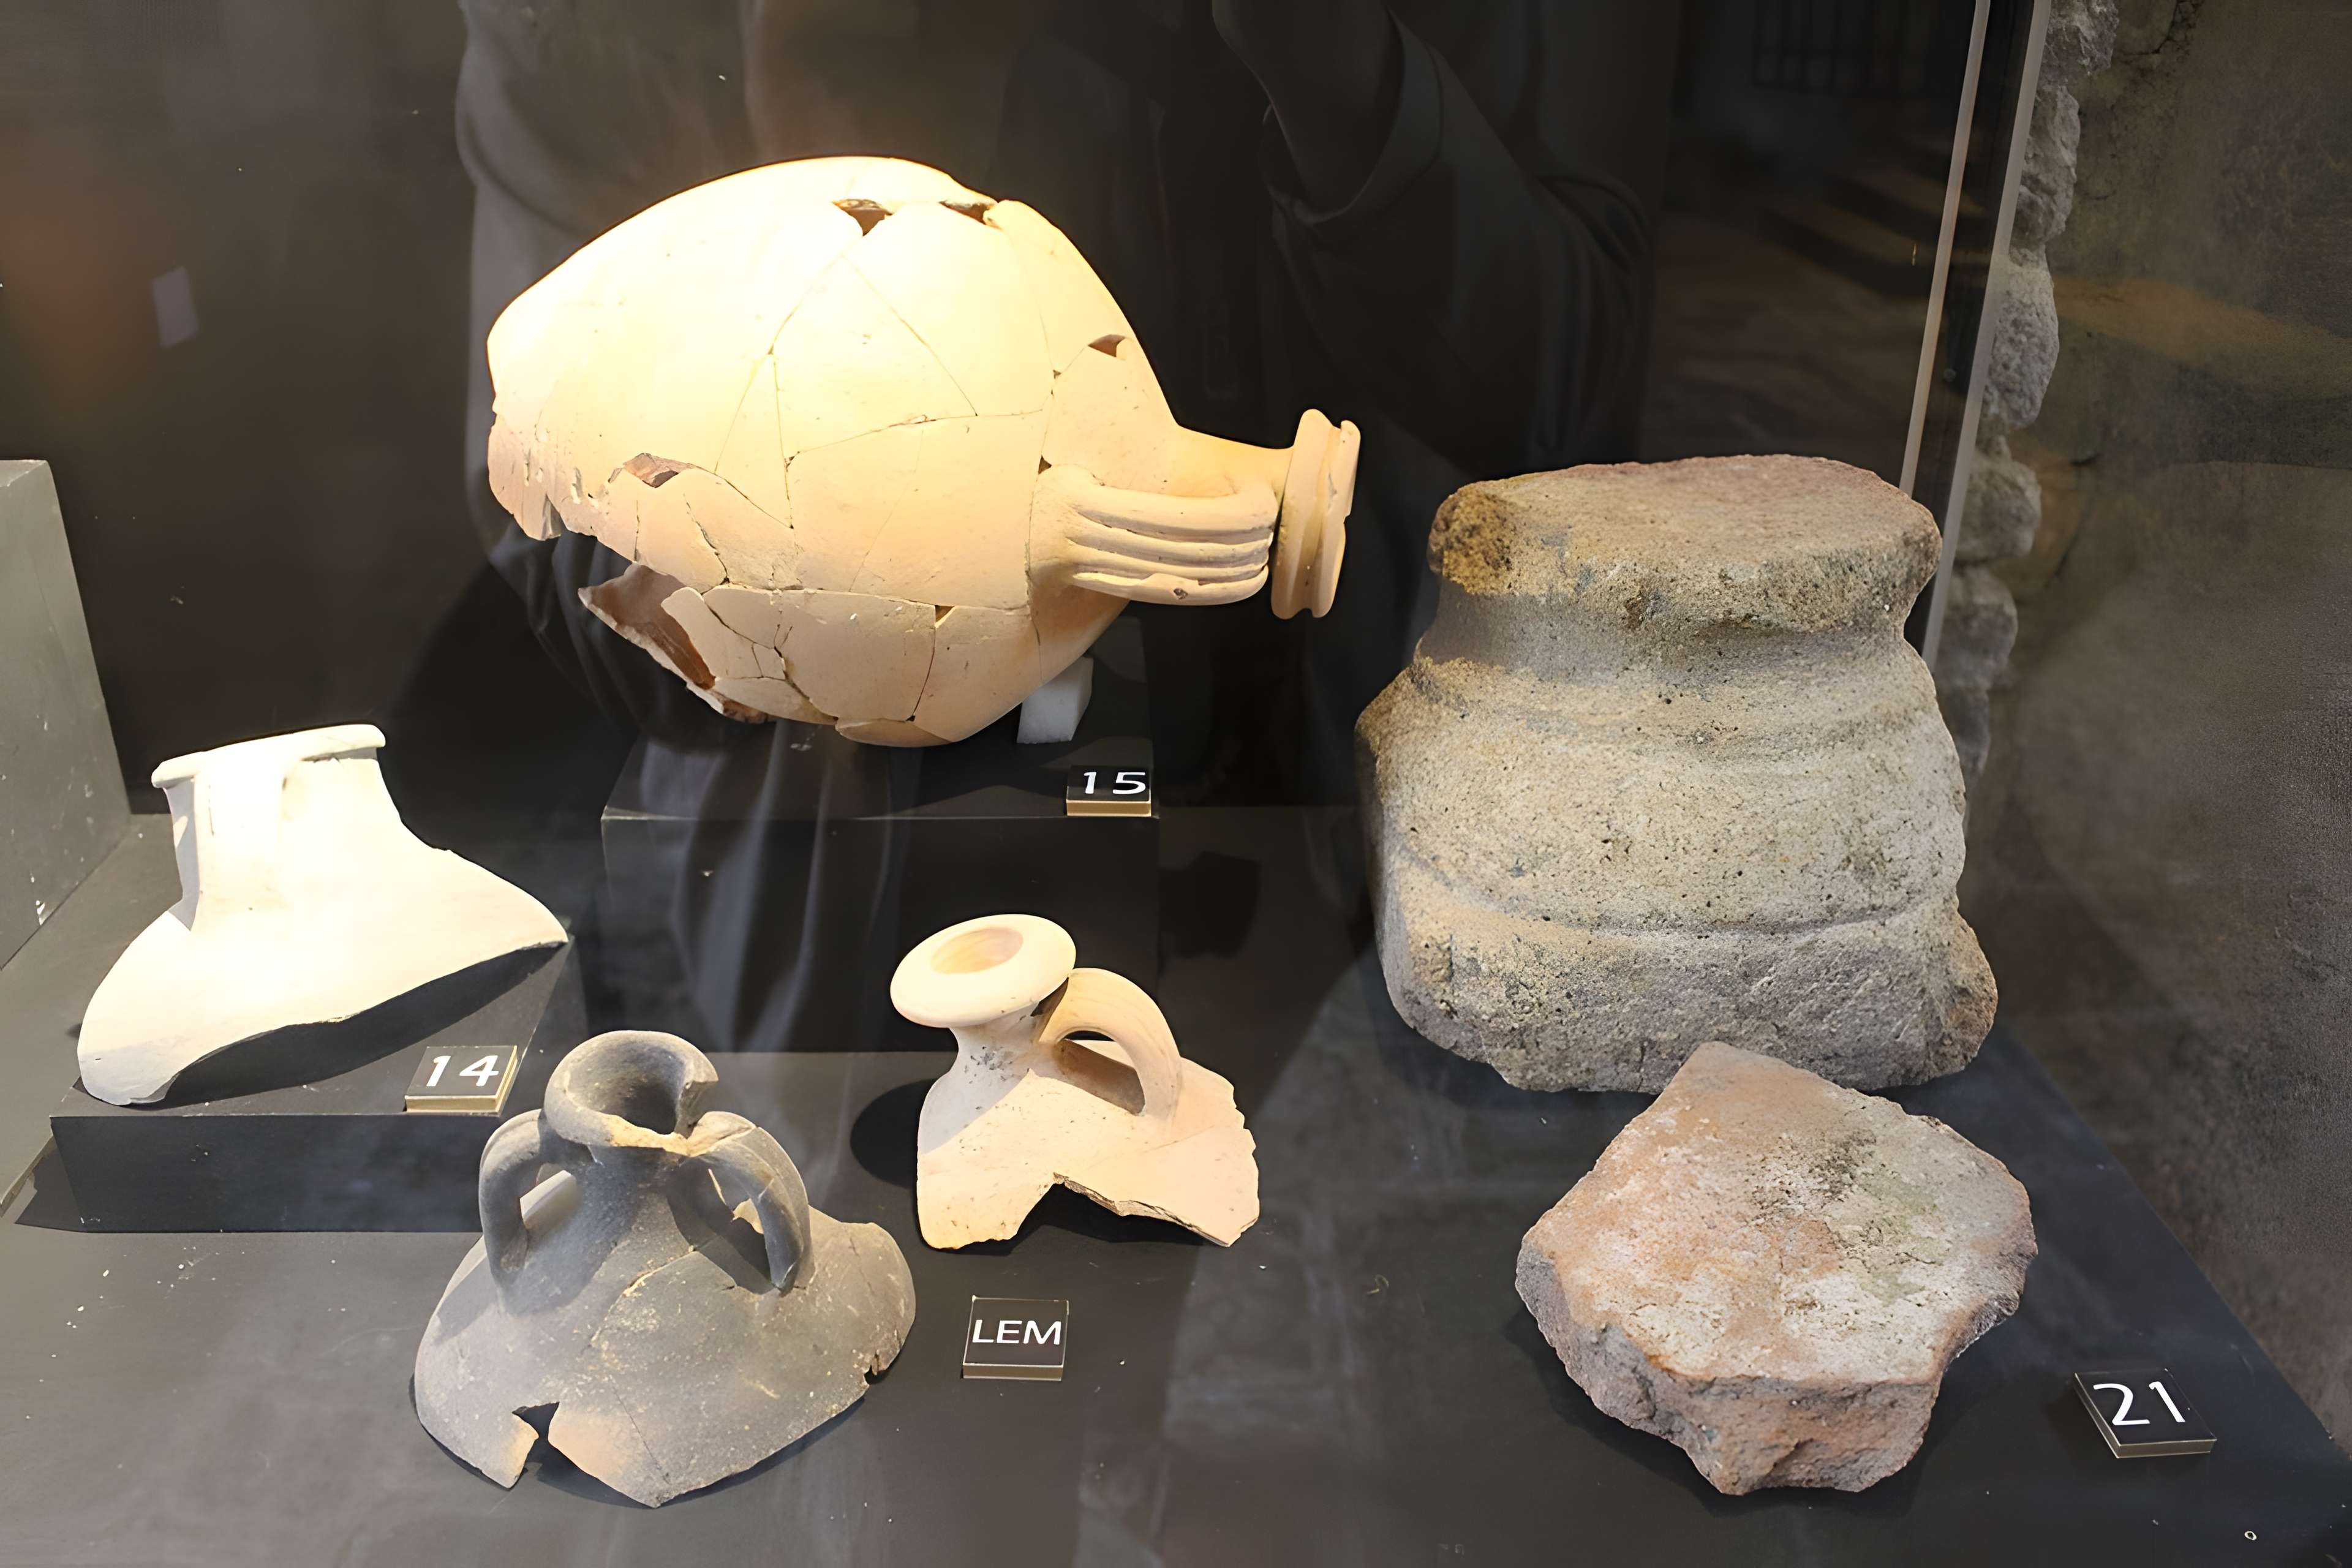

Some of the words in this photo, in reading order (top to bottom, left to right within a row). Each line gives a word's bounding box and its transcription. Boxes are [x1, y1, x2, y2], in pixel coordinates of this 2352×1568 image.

[1084, 772, 1146, 794] 15
[426, 1055, 500, 1087] 14
[972, 1319, 1061, 1344] LEM
[2093, 1381, 2186, 1426] 21
